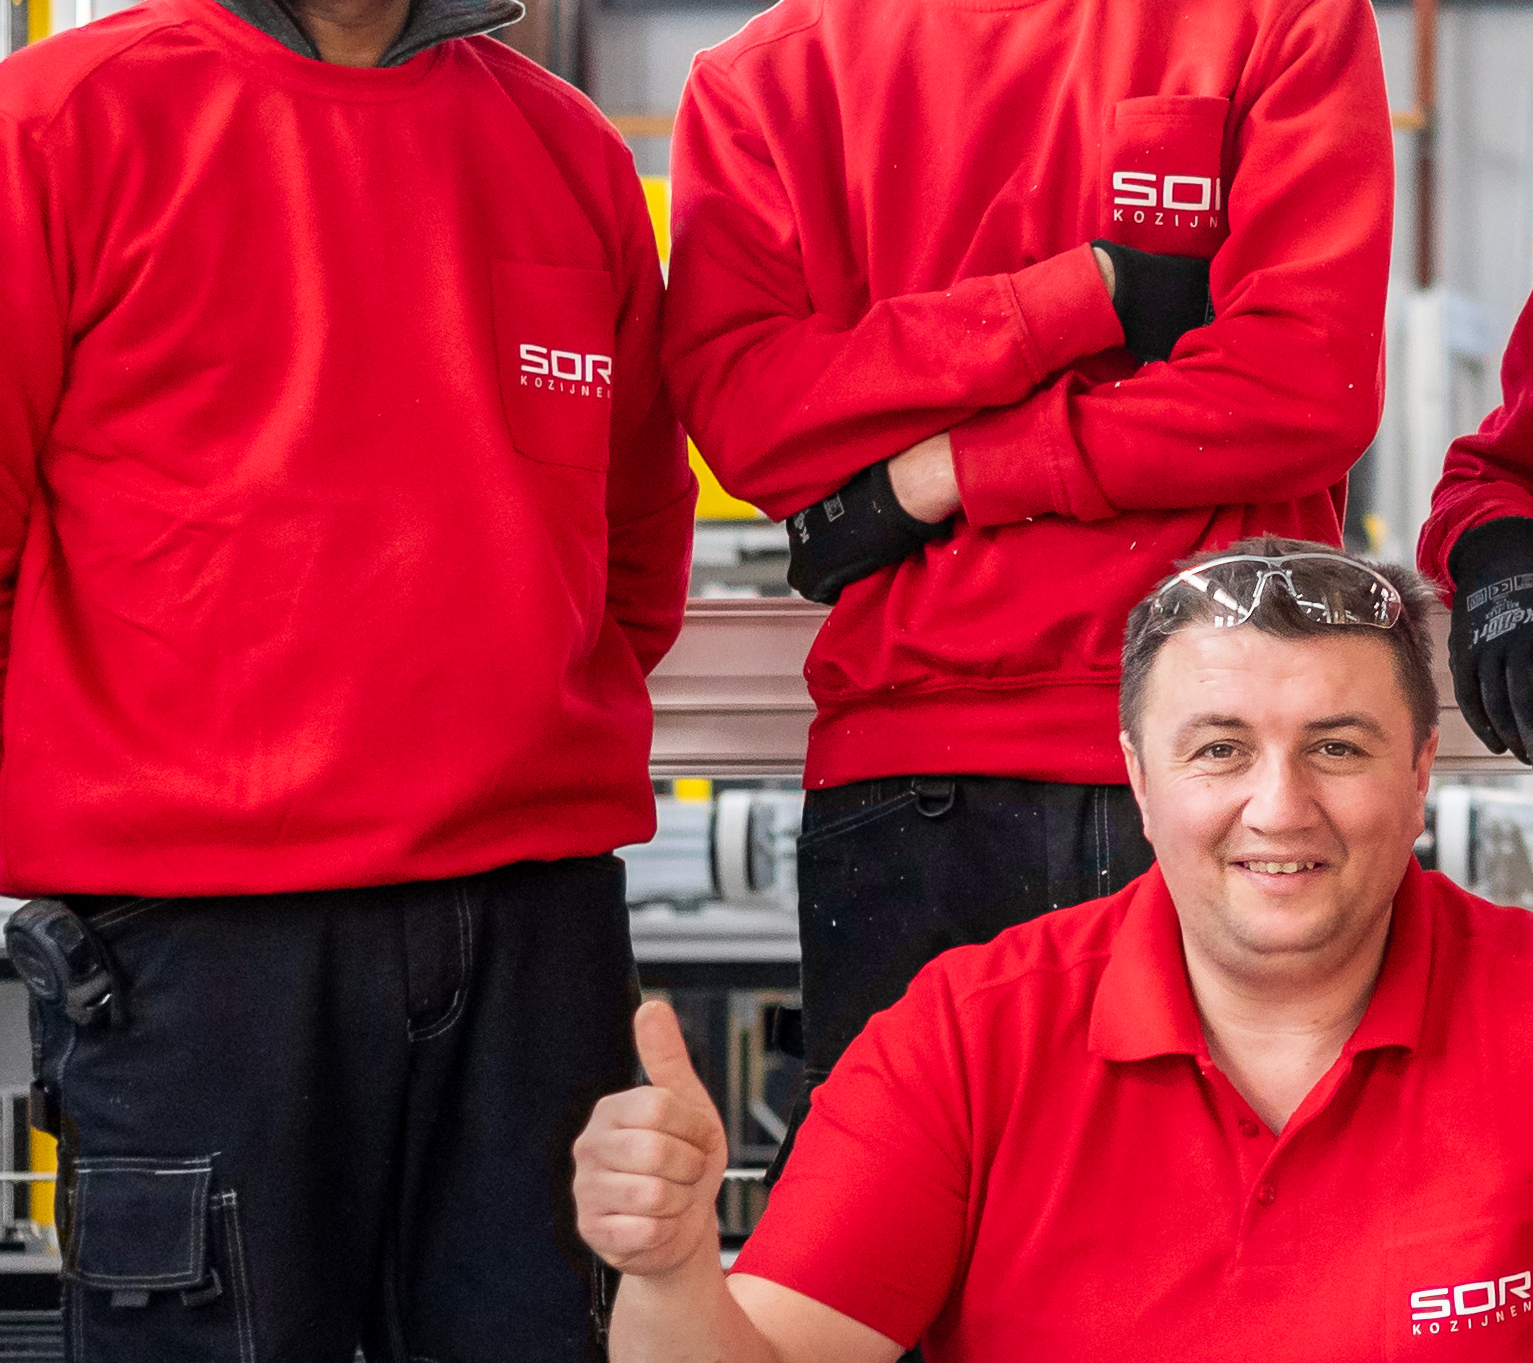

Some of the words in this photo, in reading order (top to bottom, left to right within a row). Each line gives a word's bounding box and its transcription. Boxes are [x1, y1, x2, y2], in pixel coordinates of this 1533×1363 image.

[519, 343, 612, 385] SOR
[1410, 1270, 1532, 1321] SOR
[1412, 1301, 1532, 1336] KOZIJNEN
